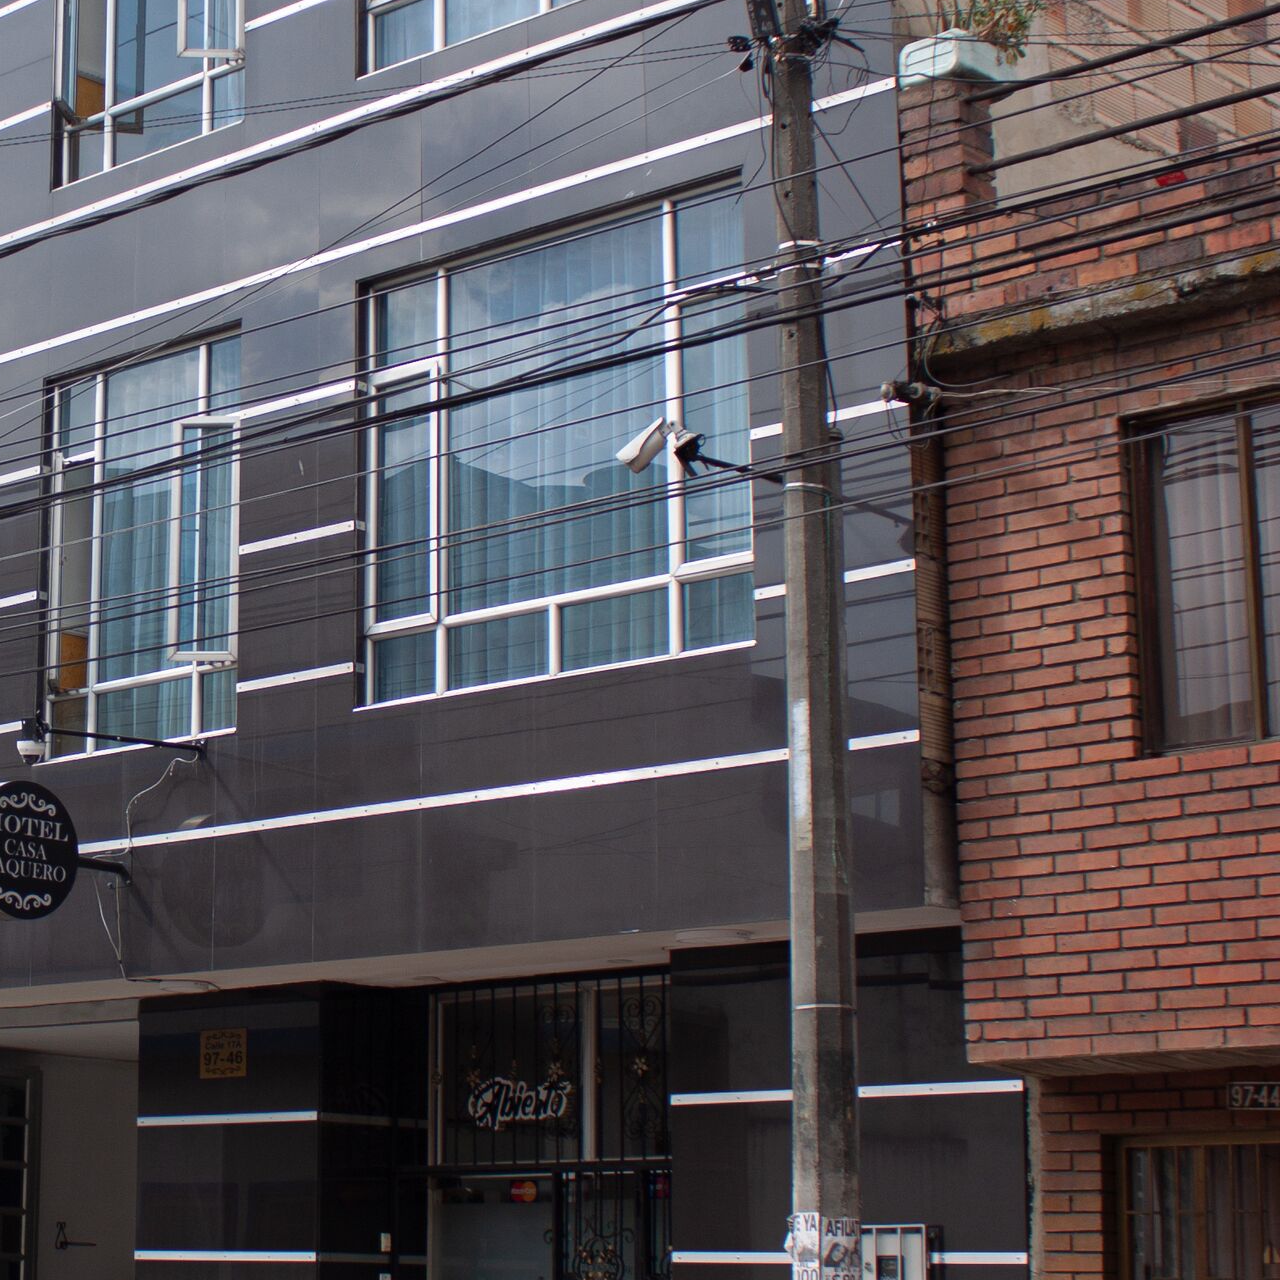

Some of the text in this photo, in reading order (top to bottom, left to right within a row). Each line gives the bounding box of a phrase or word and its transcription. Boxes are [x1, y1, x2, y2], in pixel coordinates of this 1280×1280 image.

[4, 838, 47, 861] CASA
[204, 1050, 243, 1065] 97-46
[803, 1214, 818, 1232] YA
